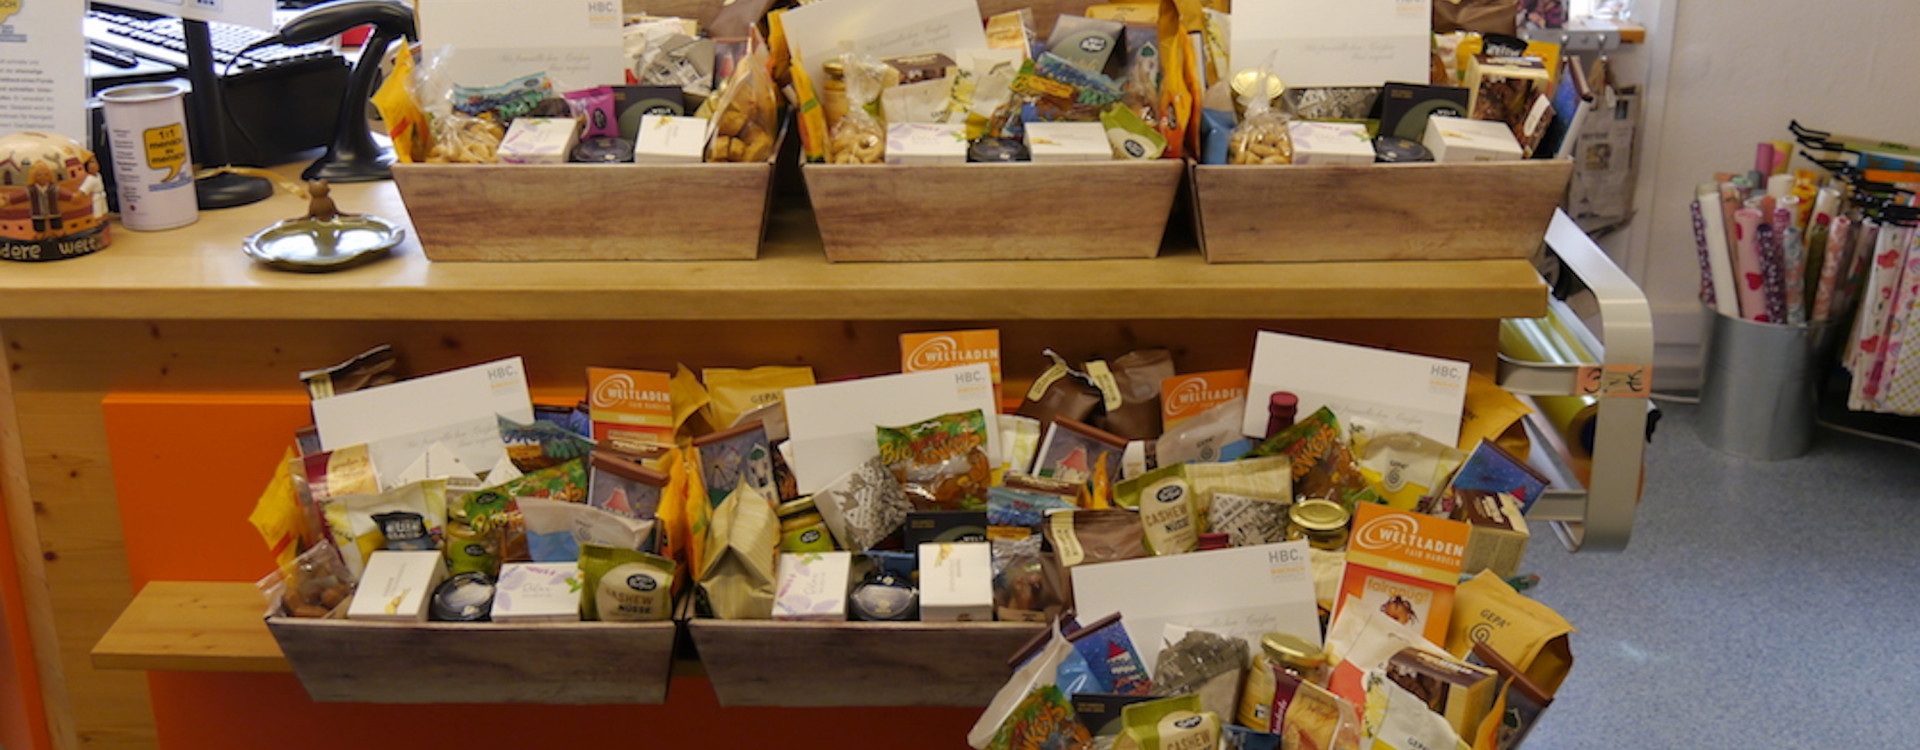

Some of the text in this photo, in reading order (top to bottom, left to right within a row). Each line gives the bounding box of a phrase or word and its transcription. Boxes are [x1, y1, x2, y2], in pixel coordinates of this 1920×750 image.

[924, 348, 999, 362] WELTLADEN
[487, 365, 518, 381] HBC.
[955, 370, 986, 384] HBC.
[1430, 363, 1462, 380] HBC.
[607, 387, 671, 403] WELTLADEN
[1144, 503, 1188, 526] CASHEW
[1379, 527, 1465, 557] WELTLADEN
[1268, 548, 1304, 563] HBC.
